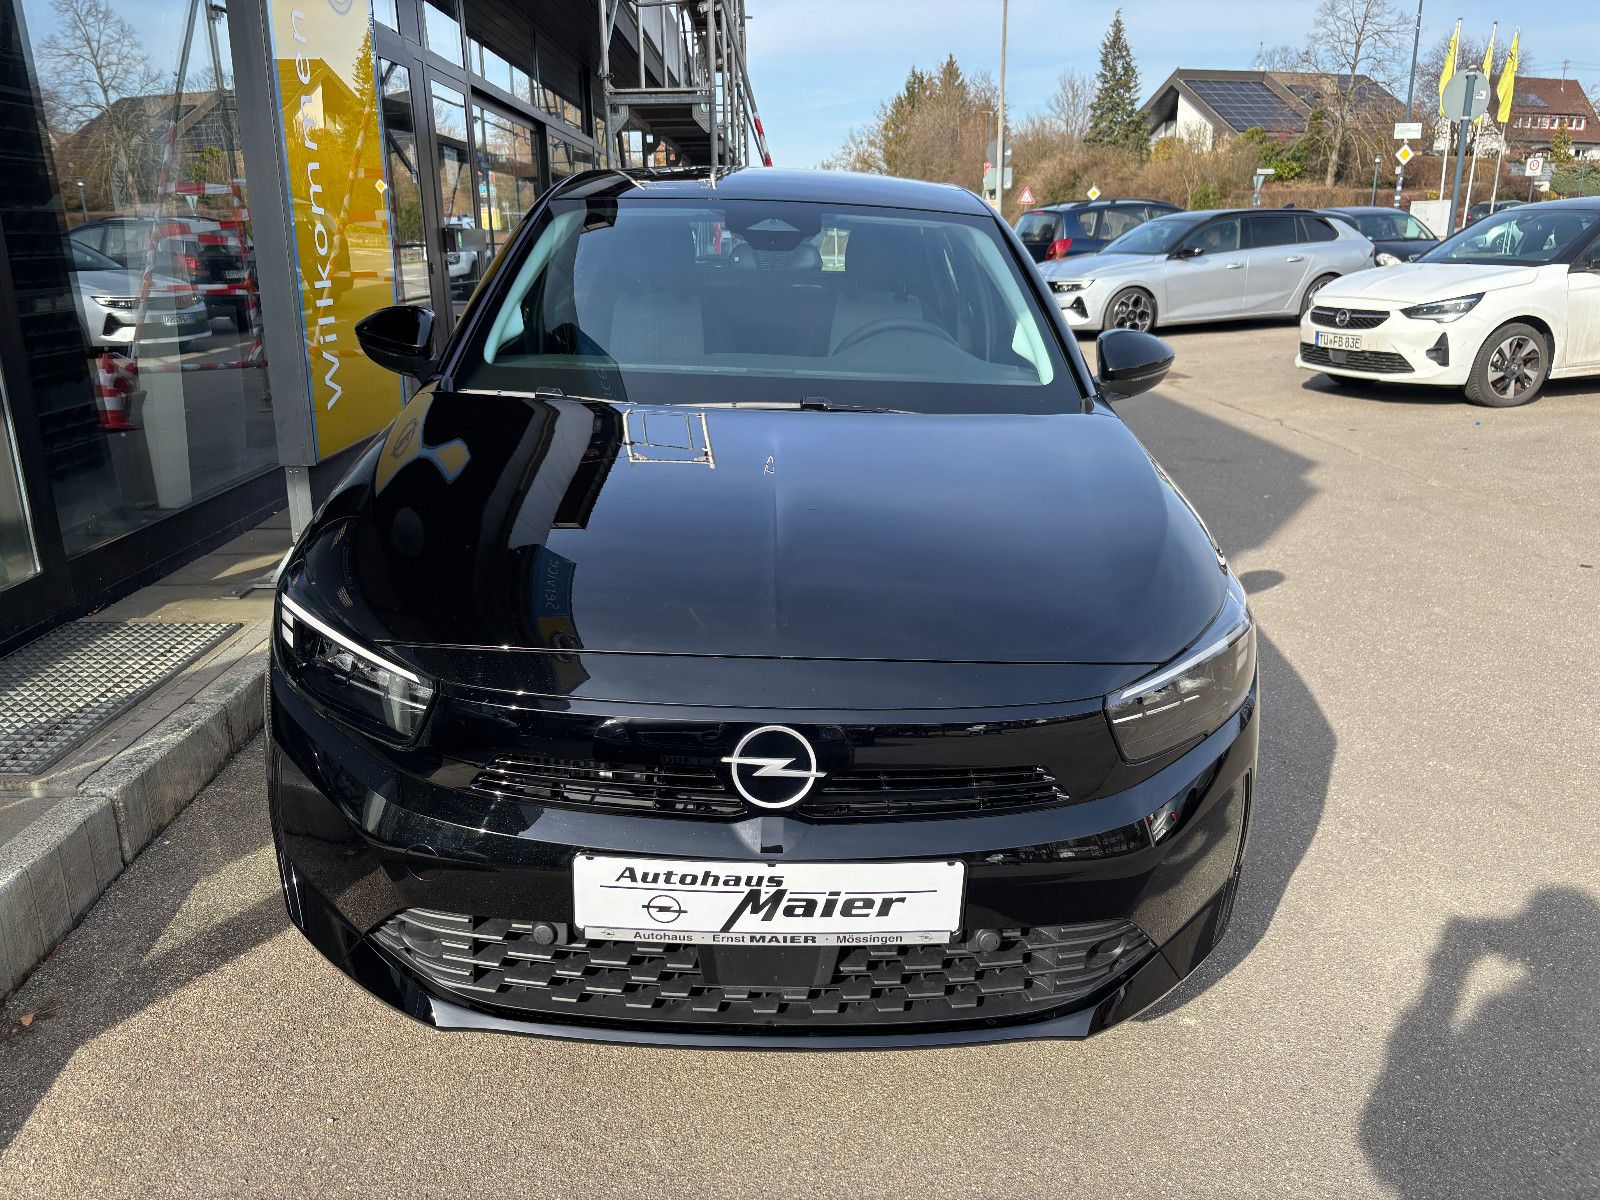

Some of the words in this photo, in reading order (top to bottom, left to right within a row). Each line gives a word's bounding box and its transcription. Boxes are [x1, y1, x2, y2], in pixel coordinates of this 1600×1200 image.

[290, 7, 343, 411] willkommen
[615, 866, 785, 888] Autohaus
[719, 888, 907, 933] Maier
[633, 931, 693, 942] Autohaus
[712, 934, 746, 944] Ernst
[749, 935, 817, 944] MAIER
[836, 934, 903, 945] Mössingen
